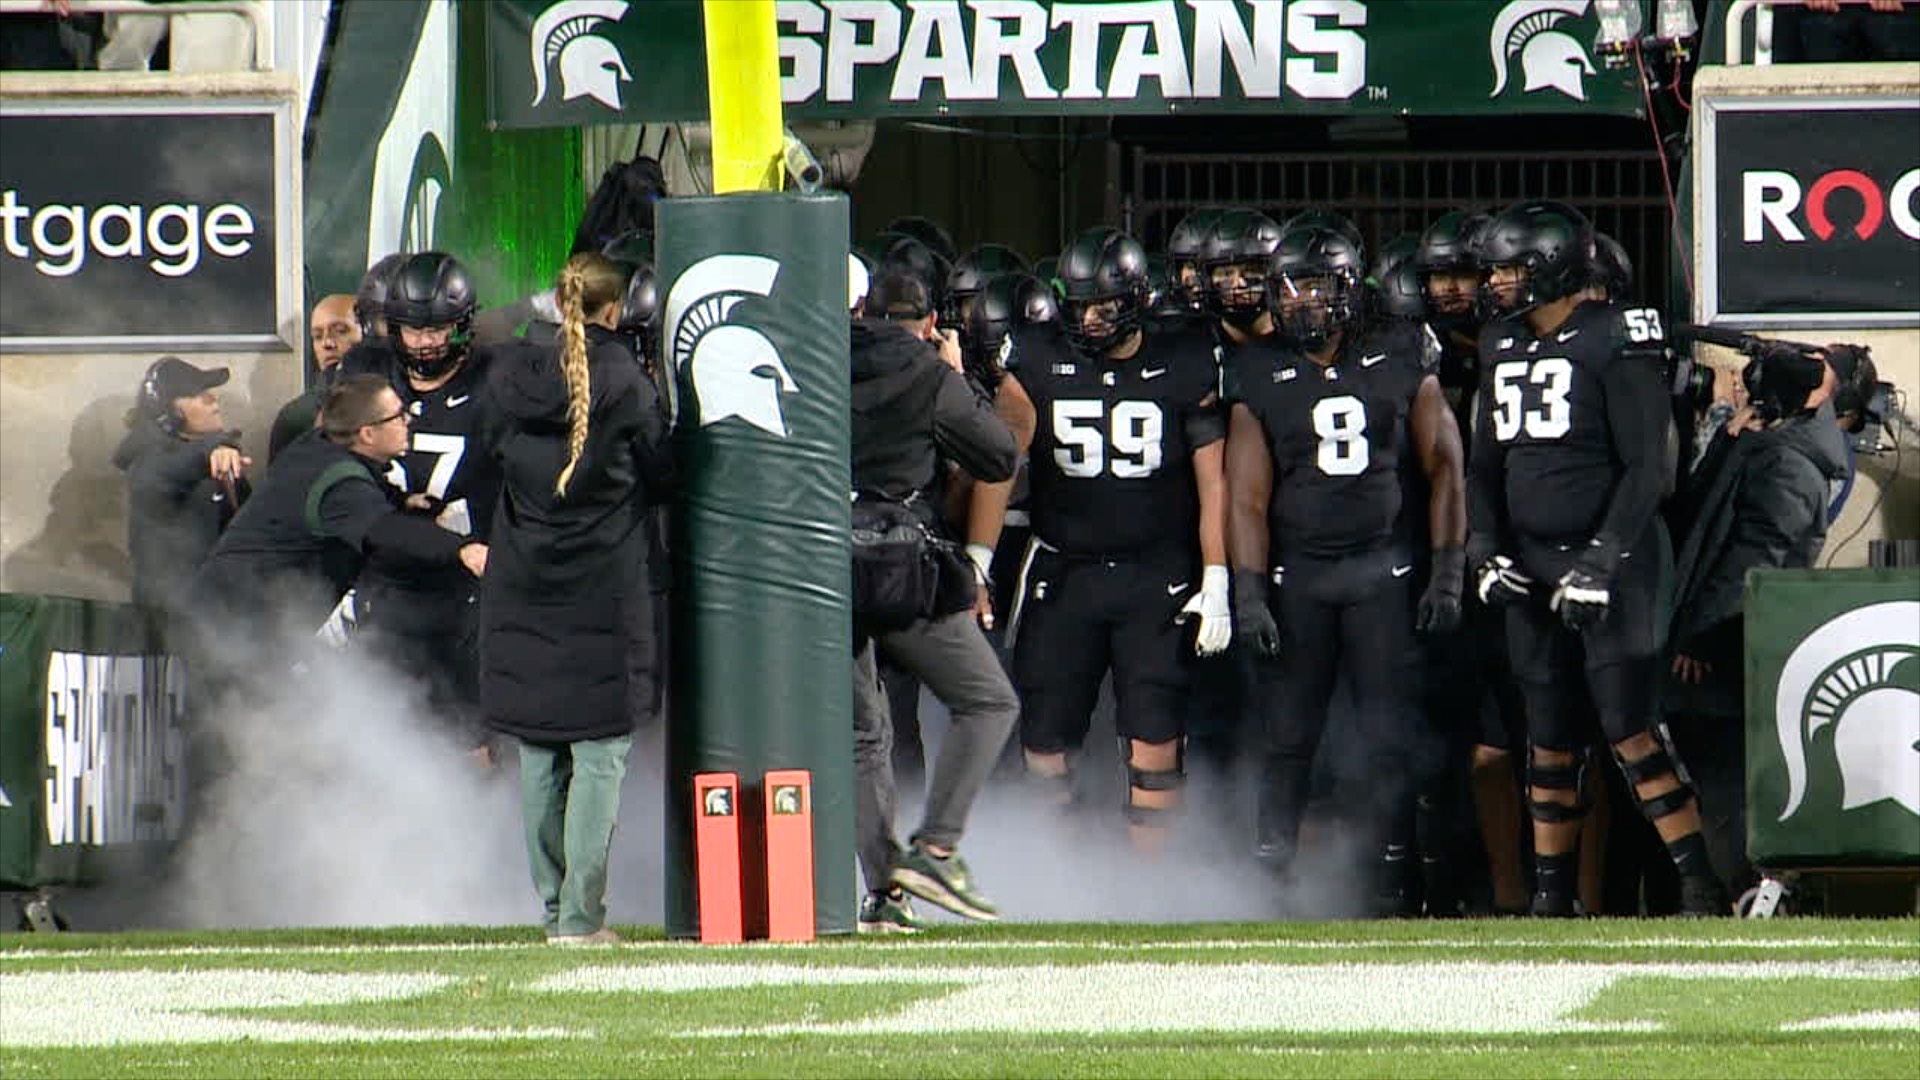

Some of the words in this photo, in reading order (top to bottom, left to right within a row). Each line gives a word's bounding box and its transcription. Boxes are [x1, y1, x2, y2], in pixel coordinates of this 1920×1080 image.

[775, 0, 1367, 102] SPARTANS
[0, 190, 254, 276] tgage
[1624, 308, 1663, 342] 53
[1053, 399, 1163, 478] 59
[1312, 395, 1369, 475] 8
[1493, 357, 1573, 441] 53
